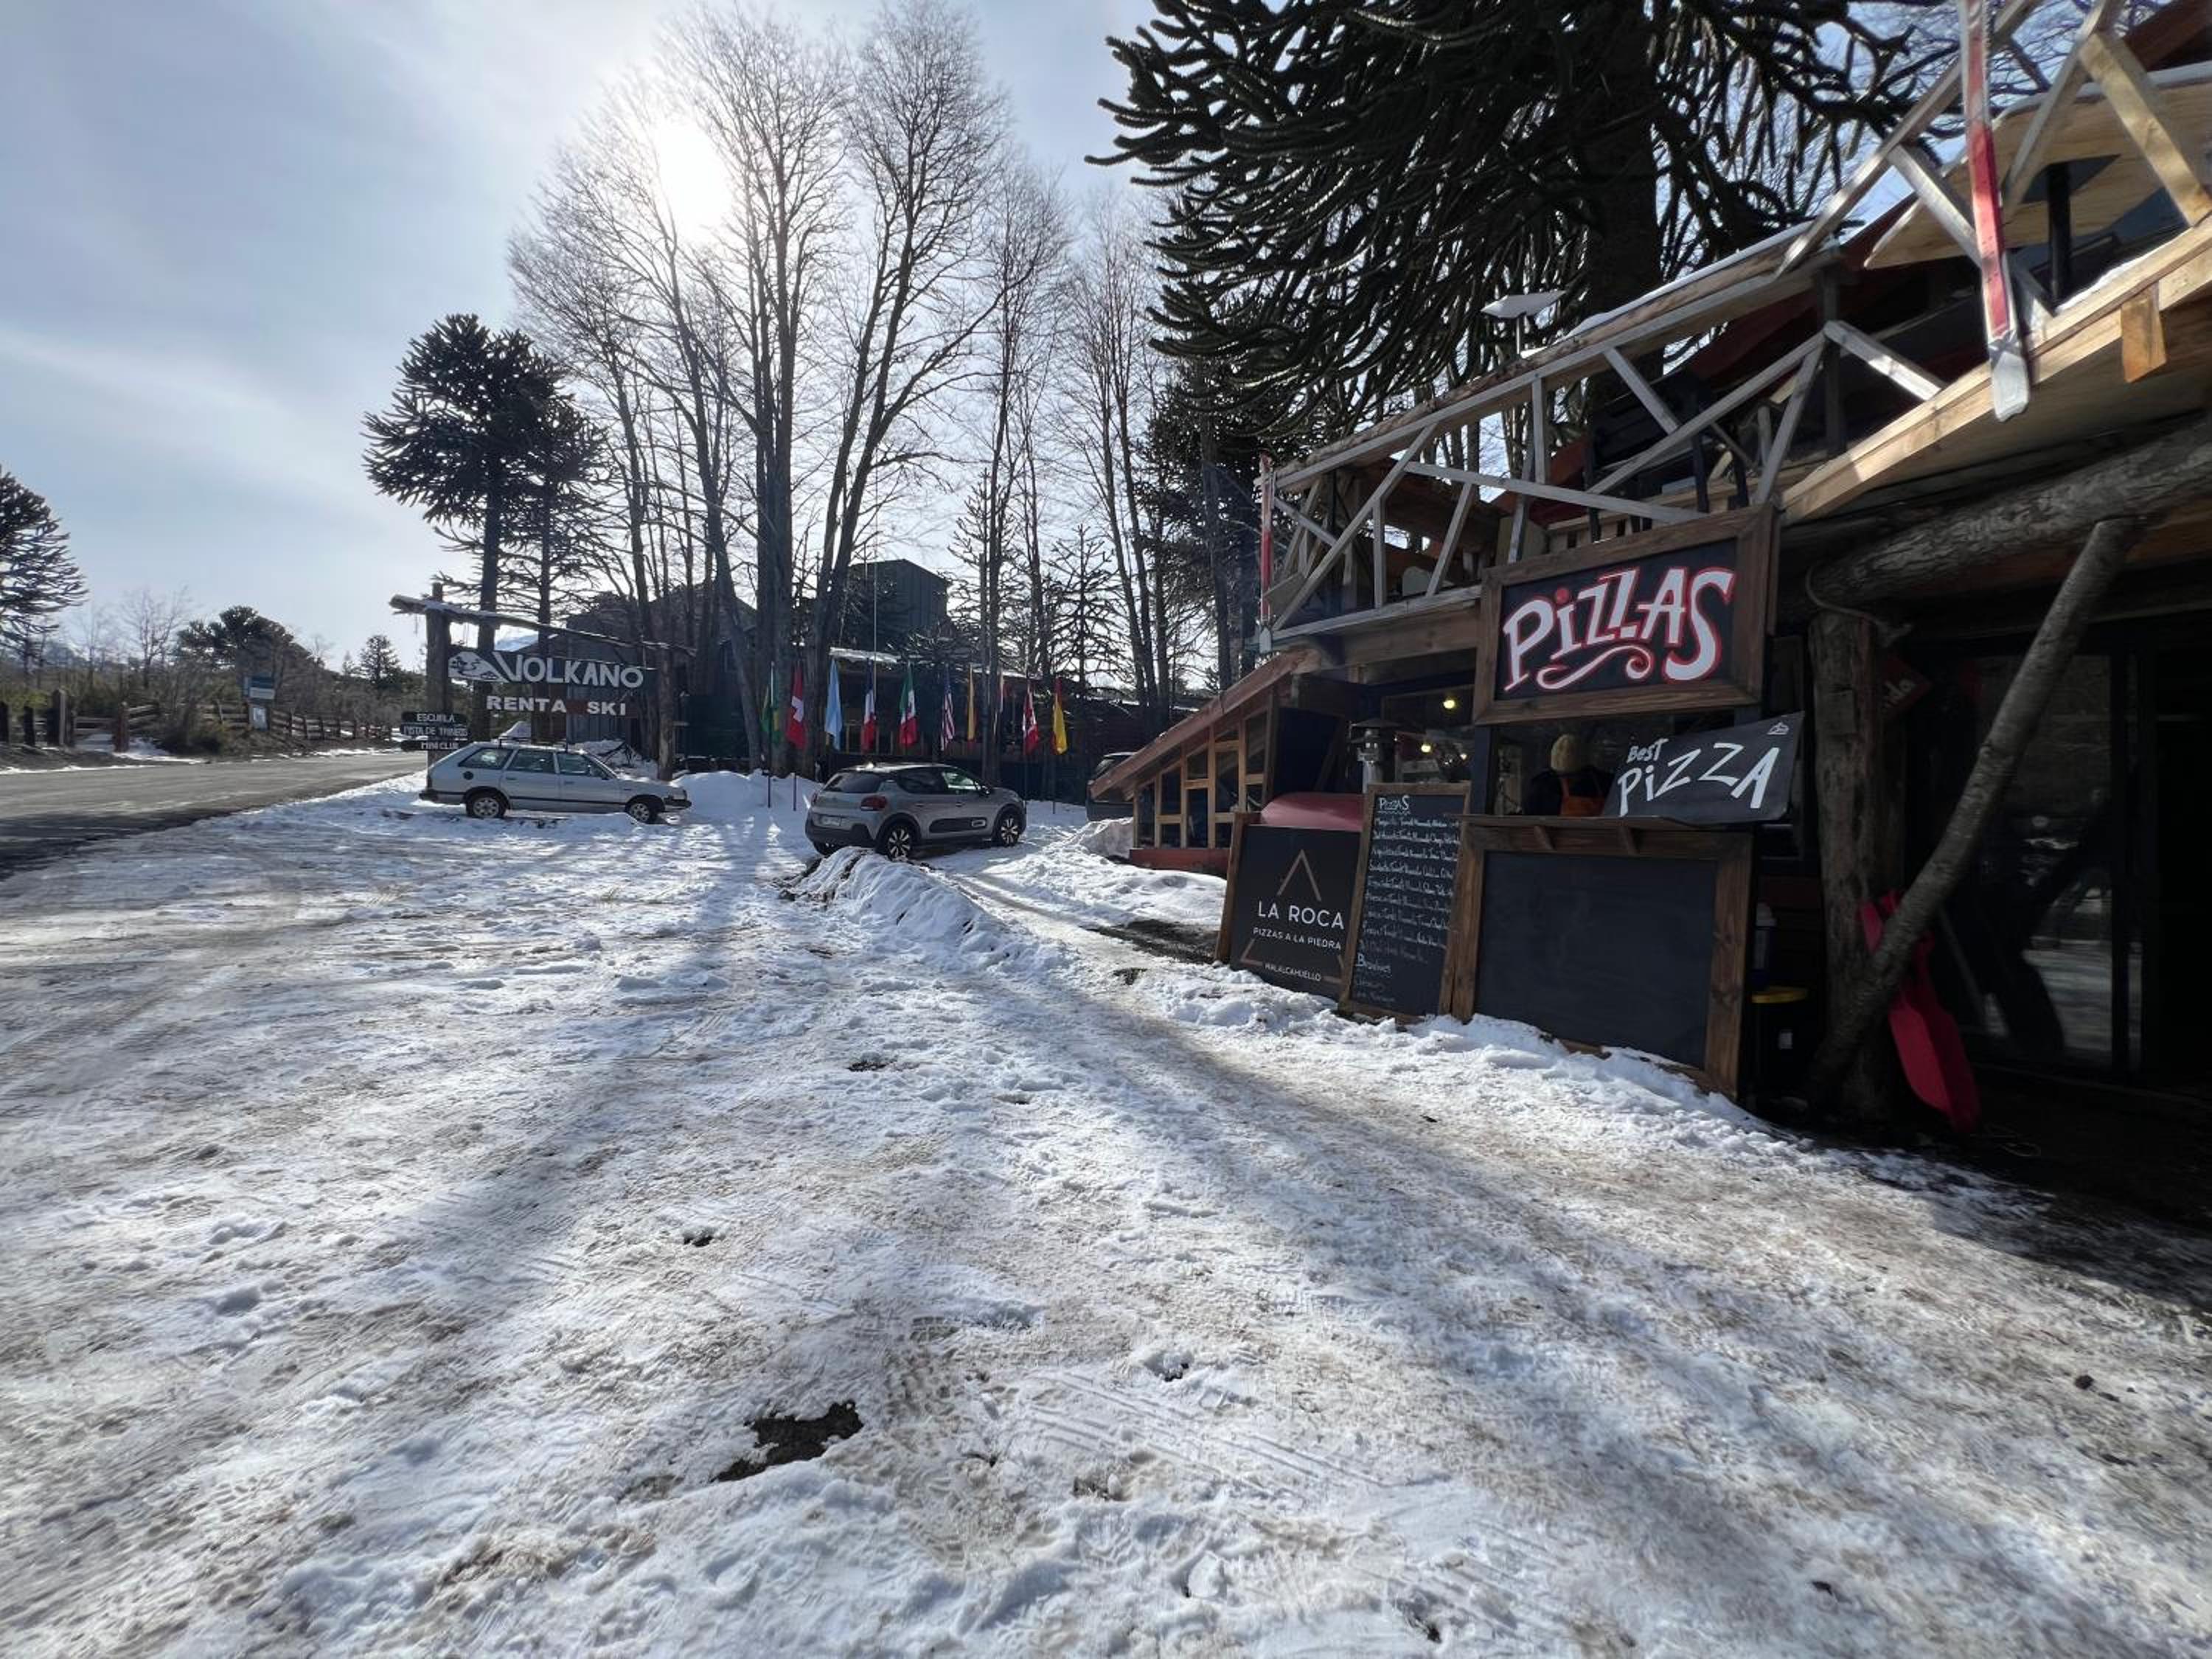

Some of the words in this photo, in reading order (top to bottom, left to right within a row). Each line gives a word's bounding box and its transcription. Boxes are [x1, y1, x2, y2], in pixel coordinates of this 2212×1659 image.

[493, 651, 644, 689] VOLKANO
[487, 695, 567, 714] RENTA
[586, 700, 626, 716] SKI
[416, 713, 456, 723] ESCUELA
[425, 726, 437, 735] DE
[1258, 900, 1279, 919] LA
[1288, 905, 1344, 930] ROCA
[1253, 927, 1284, 940] PIZZAS
[1284, 931, 1292, 941] A
[1293, 933, 1304, 945] LA
[1308, 936, 1342, 950] PIEDRA
